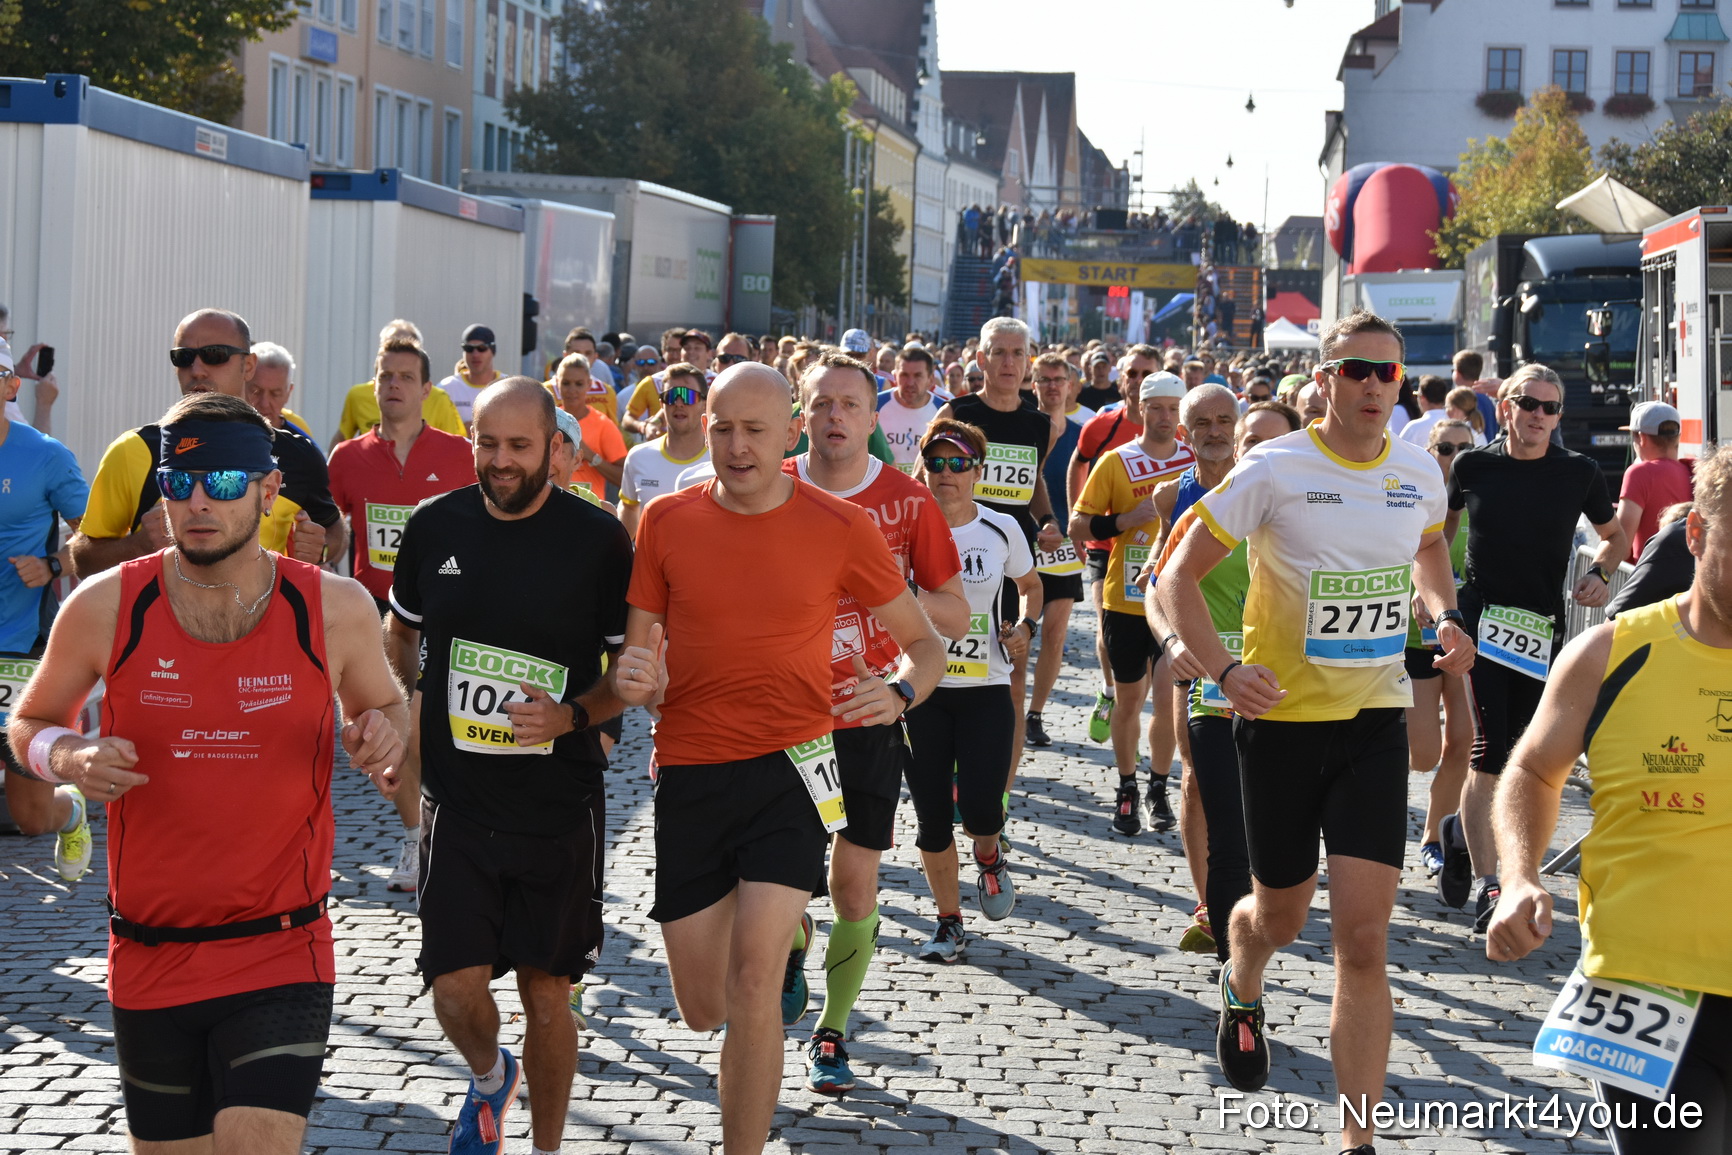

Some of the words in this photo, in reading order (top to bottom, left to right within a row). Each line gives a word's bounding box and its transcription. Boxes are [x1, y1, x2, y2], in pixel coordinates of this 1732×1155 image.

[1079, 265, 1139, 282] START
[742, 274, 771, 292] BO
[179, 437, 200, 448] NIKE
[983, 464, 1029, 485] 1126
[982, 487, 1021, 498] RUDOLF
[1307, 491, 1342, 501] BOCK
[1386, 491, 1423, 501] Neumarkter
[376, 527, 402, 549] 12
[960, 546, 989, 557] Lauftreff
[1036, 548, 1077, 566] 1385
[438, 567, 462, 575] adidas
[962, 573, 994, 584] Schwandorf
[1319, 571, 1404, 595] BOCK
[1320, 601, 1401, 634] 2775
[1488, 608, 1549, 636] BOCK
[1487, 624, 1542, 659] 2792
[151, 670, 180, 680] erima
[457, 647, 556, 688] BOCK
[238, 674, 293, 687] HEINLOTH
[457, 680, 534, 721] 104
[181, 729, 250, 740] Gruber
[466, 725, 515, 744] SVEN
[1642, 752, 1706, 767] NEUMARKTER
[1647, 766, 1700, 774] MINERALBRUNNEN
[1641, 791, 1660, 807] M
[1666, 792, 1684, 808] &
[1693, 792, 1706, 809] S
[1557, 983, 1671, 1047] 2552
[1677, 1015, 1685, 1025] D
[1549, 1034, 1647, 1076] JOACHIM
